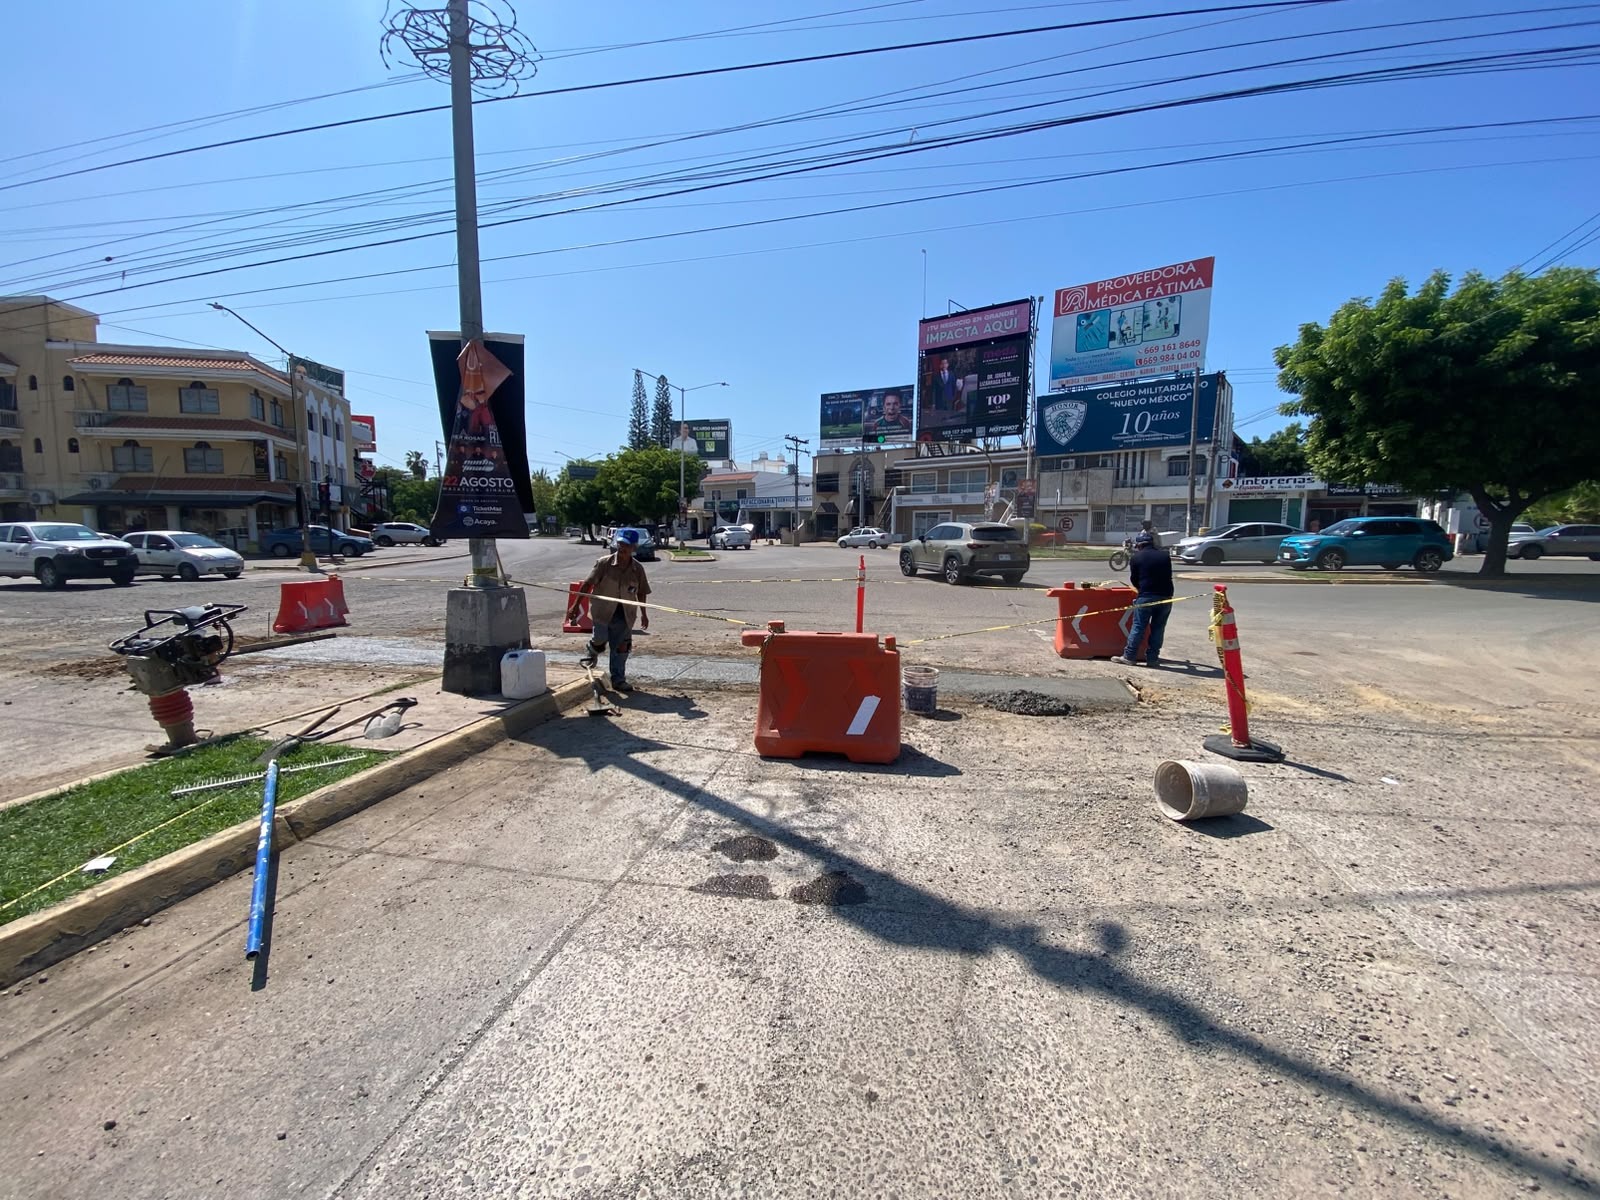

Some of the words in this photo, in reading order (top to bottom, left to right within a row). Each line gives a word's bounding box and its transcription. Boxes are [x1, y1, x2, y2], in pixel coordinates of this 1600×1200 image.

[1097, 262, 1196, 292] PROVEEDORA
[1087, 290, 1142, 311] MÉDICA
[1145, 277, 1205, 299] FÁTIMA
[926, 326, 979, 344] IMPACTA
[983, 318, 1018, 333] AQUI
[940, 318, 971, 329] NEGOCIO
[1144, 346, 1159, 355] 669
[1161, 344, 1177, 353] 161
[1178, 340, 1201, 351] 8649
[1143, 355, 1158, 365] 669
[1160, 353, 1175, 363] 984
[1176, 352, 1188, 362] 04
[1189, 349, 1201, 360] 00
[985, 393, 1011, 406] TOP
[1096, 389, 1136, 401] COLEGIO
[1120, 410, 1151, 436] 10
[1151, 409, 1181, 421] años
[459, 476, 514, 488] AGOSTO
